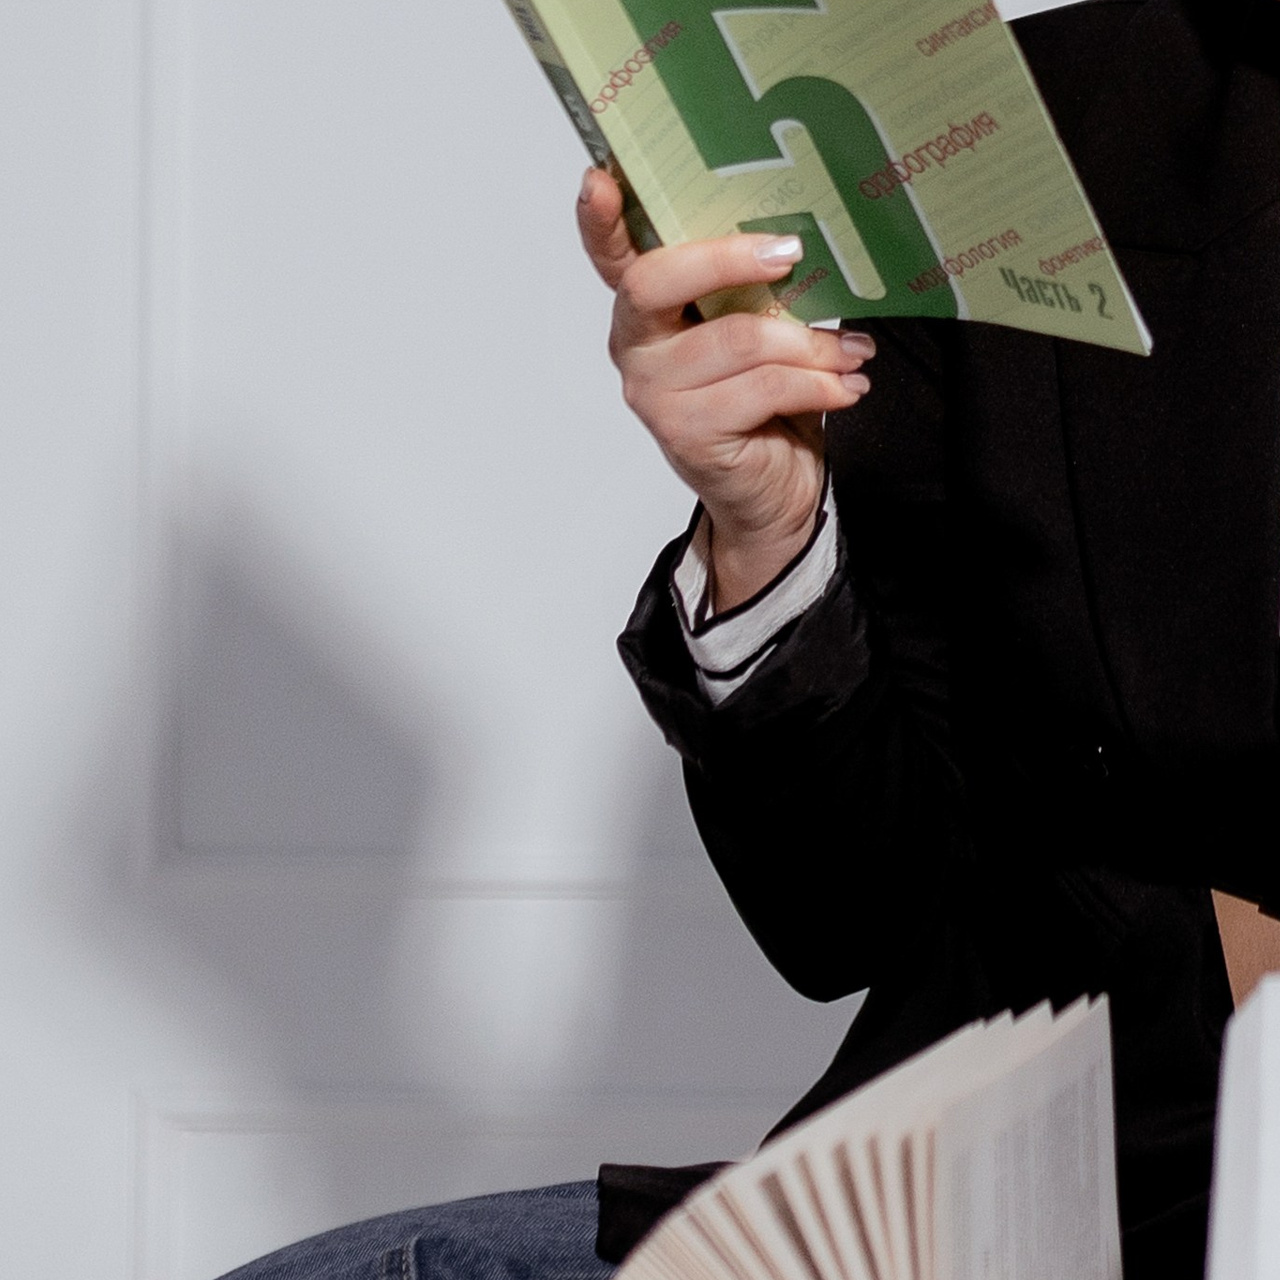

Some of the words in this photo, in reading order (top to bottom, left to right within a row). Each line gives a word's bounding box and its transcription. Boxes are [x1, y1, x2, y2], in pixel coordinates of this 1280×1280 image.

[858, 111, 1000, 200] орфография
[907, 229, 1023, 297] морфология
[998, 266, 1082, 314] Часть
[1087, 282, 1114, 320] 2
